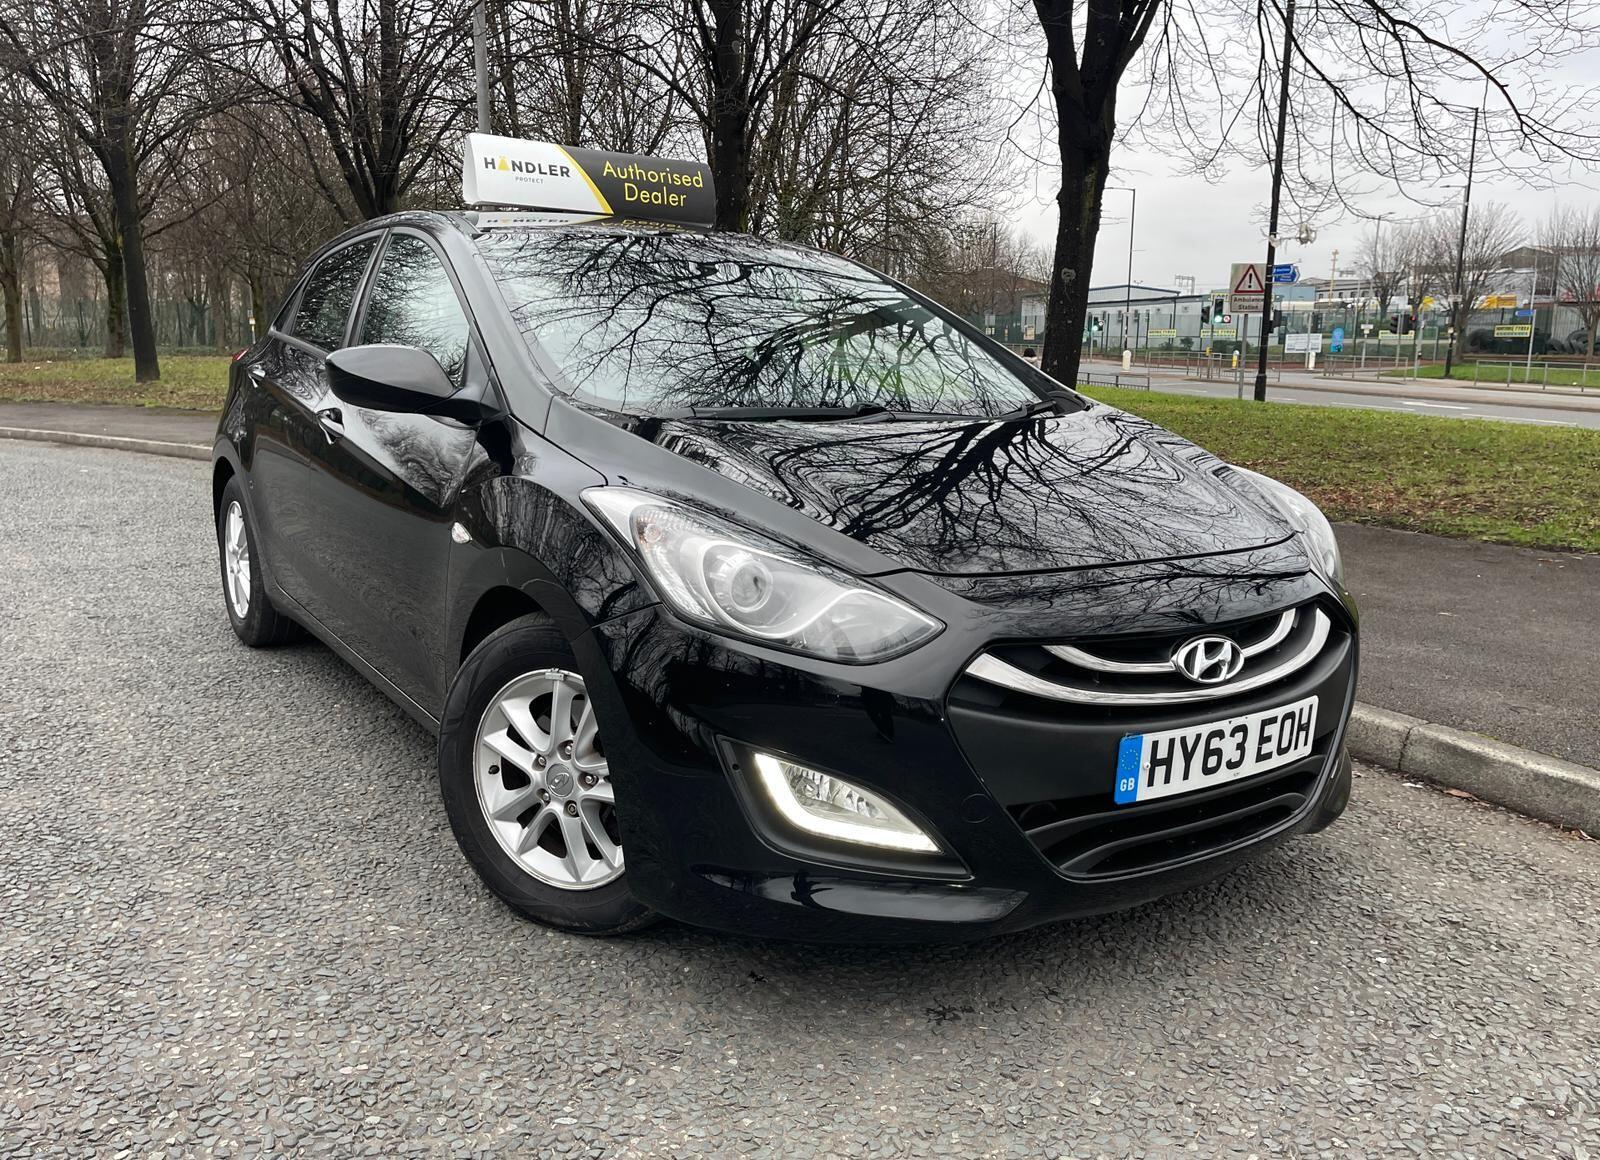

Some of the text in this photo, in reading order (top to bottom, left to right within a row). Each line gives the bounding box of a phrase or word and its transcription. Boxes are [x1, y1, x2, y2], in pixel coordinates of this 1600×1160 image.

[515, 176, 544, 184] PROTECT
[602, 160, 704, 188] Authorised
[623, 181, 688, 207] Dealer
[1146, 703, 1314, 788] HY63 EOH
[1119, 777, 1136, 792] GB
